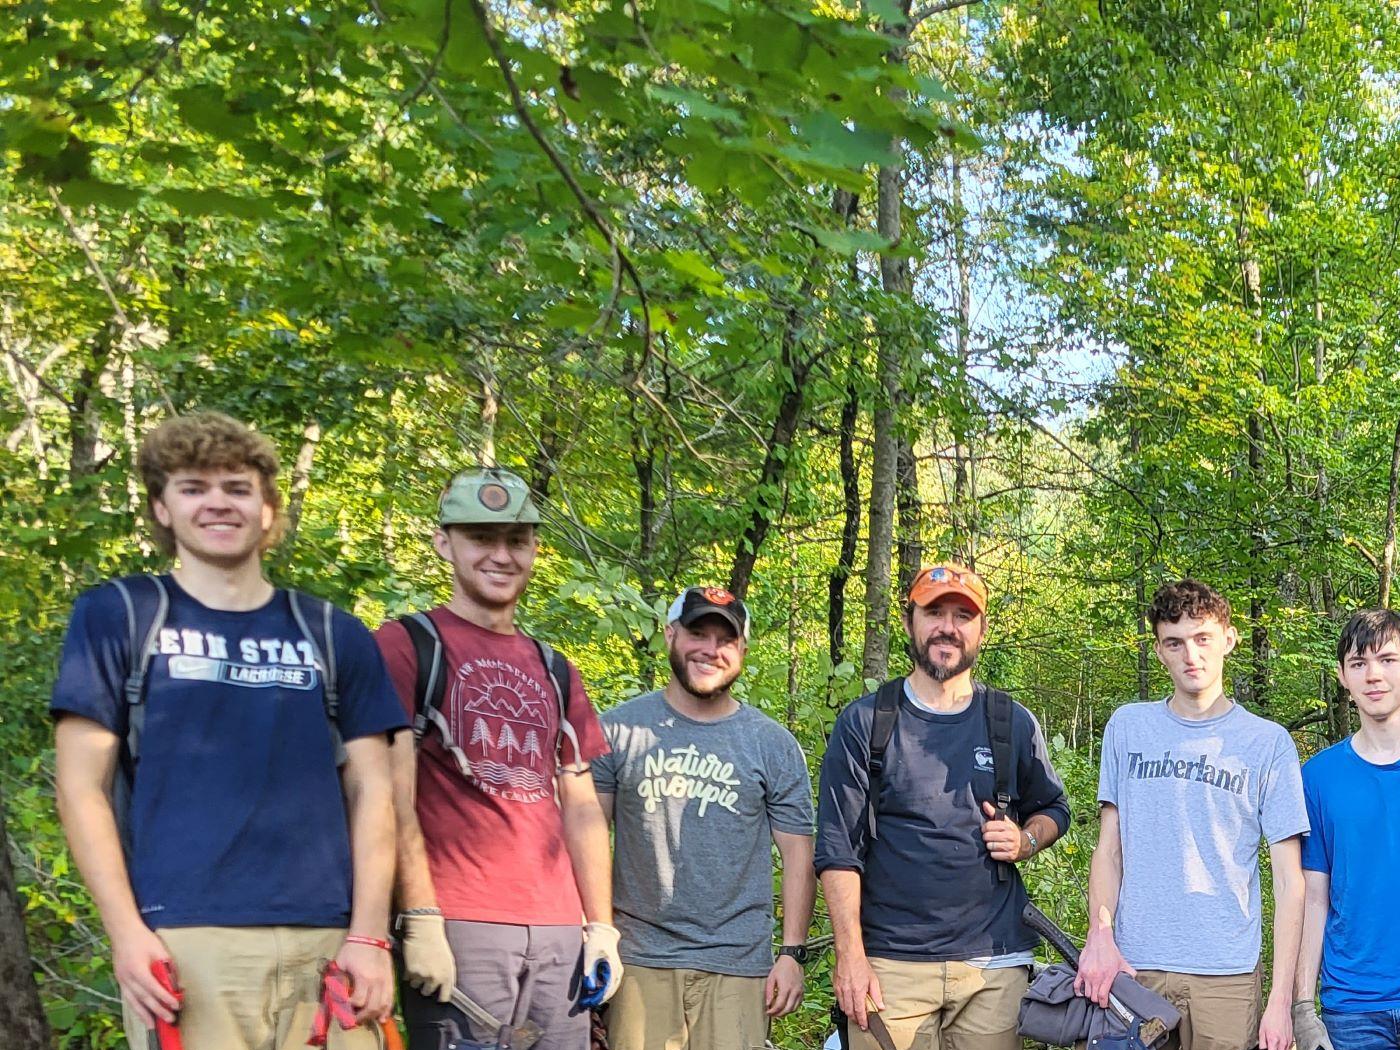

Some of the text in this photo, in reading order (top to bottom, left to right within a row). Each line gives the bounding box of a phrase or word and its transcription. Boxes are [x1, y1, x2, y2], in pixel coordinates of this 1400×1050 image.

[149, 627, 323, 670] ENN STAT
[229, 665, 306, 685] LACROSSE
[644, 743, 741, 786] Nature
[1127, 750, 1248, 795] Timberland
[637, 775, 741, 818] groupie
